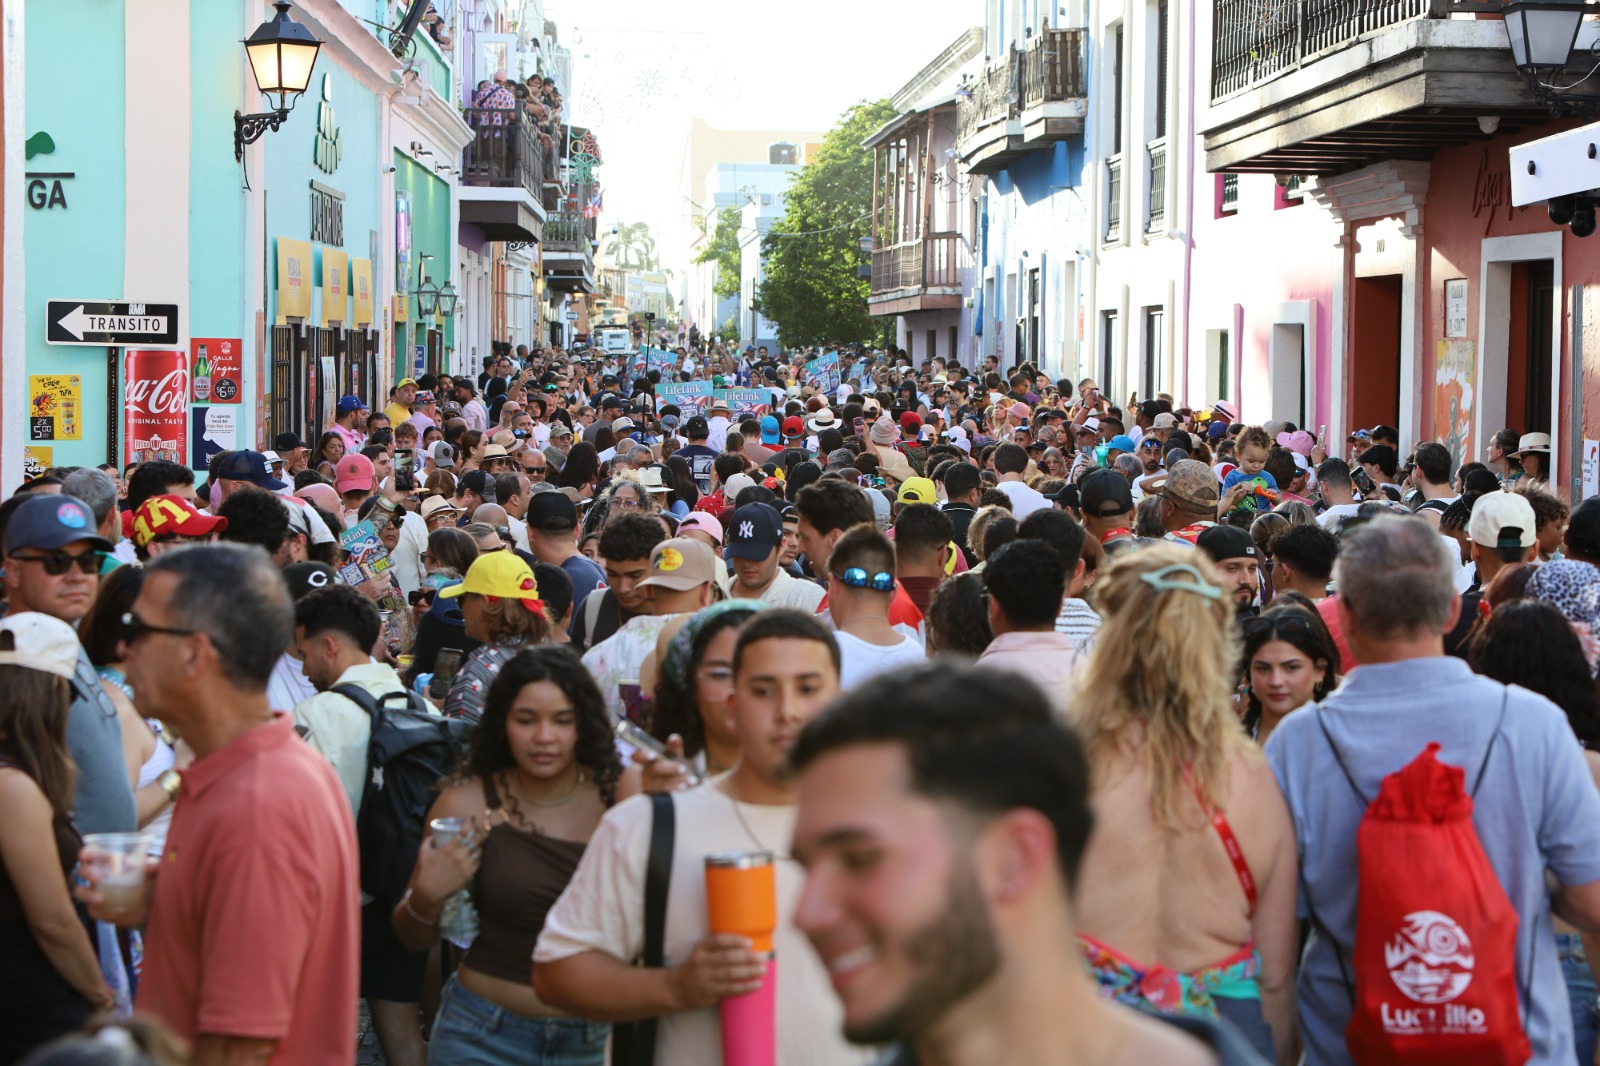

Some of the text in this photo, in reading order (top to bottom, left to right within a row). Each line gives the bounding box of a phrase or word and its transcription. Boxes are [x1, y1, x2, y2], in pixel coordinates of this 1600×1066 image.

[27, 179, 68, 210] GA
[89, 316, 161, 332] TRANSITO
[205, 359, 240, 377] Magna
[665, 382, 701, 395] LifeLink
[724, 391, 760, 401] LifeLink
[340, 527, 368, 546] feLink
[738, 520, 754, 539] NY
[307, 570, 328, 587] C
[1380, 1002, 1485, 1028] Luillo
